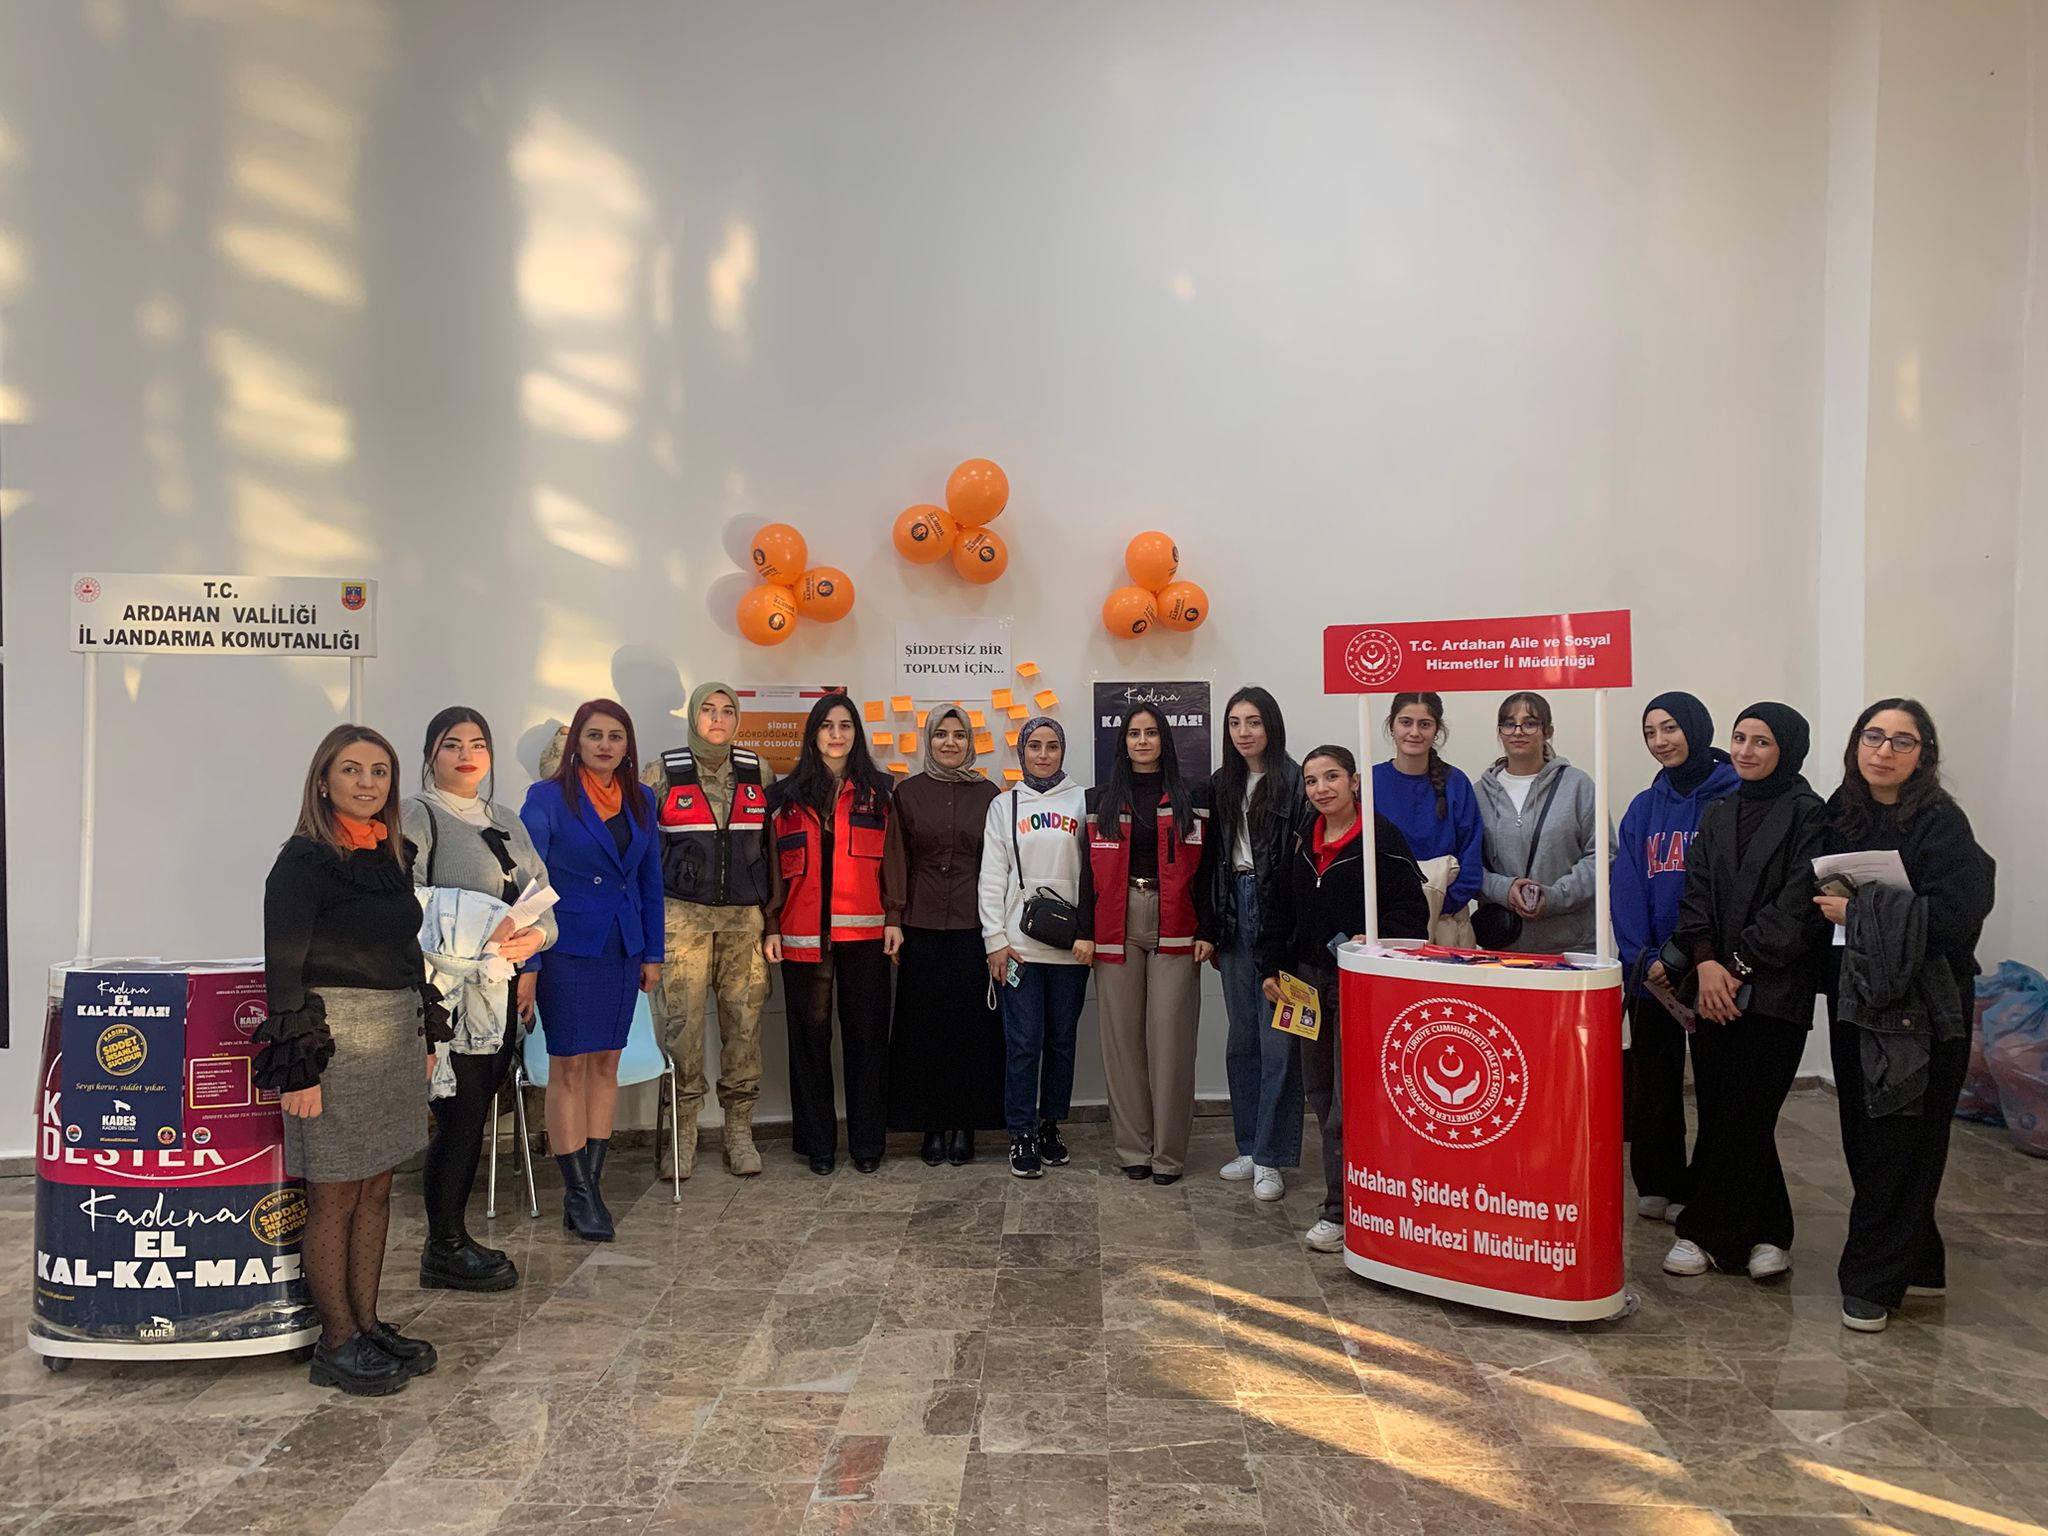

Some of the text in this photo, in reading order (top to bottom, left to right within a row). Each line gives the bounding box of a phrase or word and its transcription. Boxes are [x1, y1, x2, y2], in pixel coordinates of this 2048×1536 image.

[204, 582, 238, 599] T.C.
[123, 604, 316, 625] ARDAHAN VALİLİĞİ
[79, 624, 360, 650] İL JANDARMA KOMUTANLIĞI
[1409, 633, 1611, 652] T.C. Ardahan Aile ve Sosyal
[904, 642, 1003, 657] ŞİDDETSİZ BİR
[903, 661, 1004, 676] TOPLUM İÇİN...
[1426, 654, 1595, 670] Hizmetler İl Müdürlüğü
[763, 739, 801, 747] OLDUĞU
[1018, 812, 1079, 836] WONDER
[97, 979, 151, 996] Kadına
[114, 995, 131, 1006] EL
[77, 1005, 171, 1017] KAL-KA-MAZ!
[1405, 1024, 1501, 1123] TÜRKİYE CUMHURİYETİ AİLE VE SOSYAL HİZMETLER BAKANLIĞI
[102, 1115, 137, 1126] KADES
[1347, 1161, 1578, 1222] Ardahan Şiddet Önleme ve
[79, 1188, 250, 1231] Kadına
[260, 1193, 295, 1211] KADINA
[1349, 1196, 1577, 1272] İzleme Merkezi Müdürlüğü
[134, 1231, 186, 1258] EL
[37, 1250, 306, 1289] KAL-KA-MAZ
